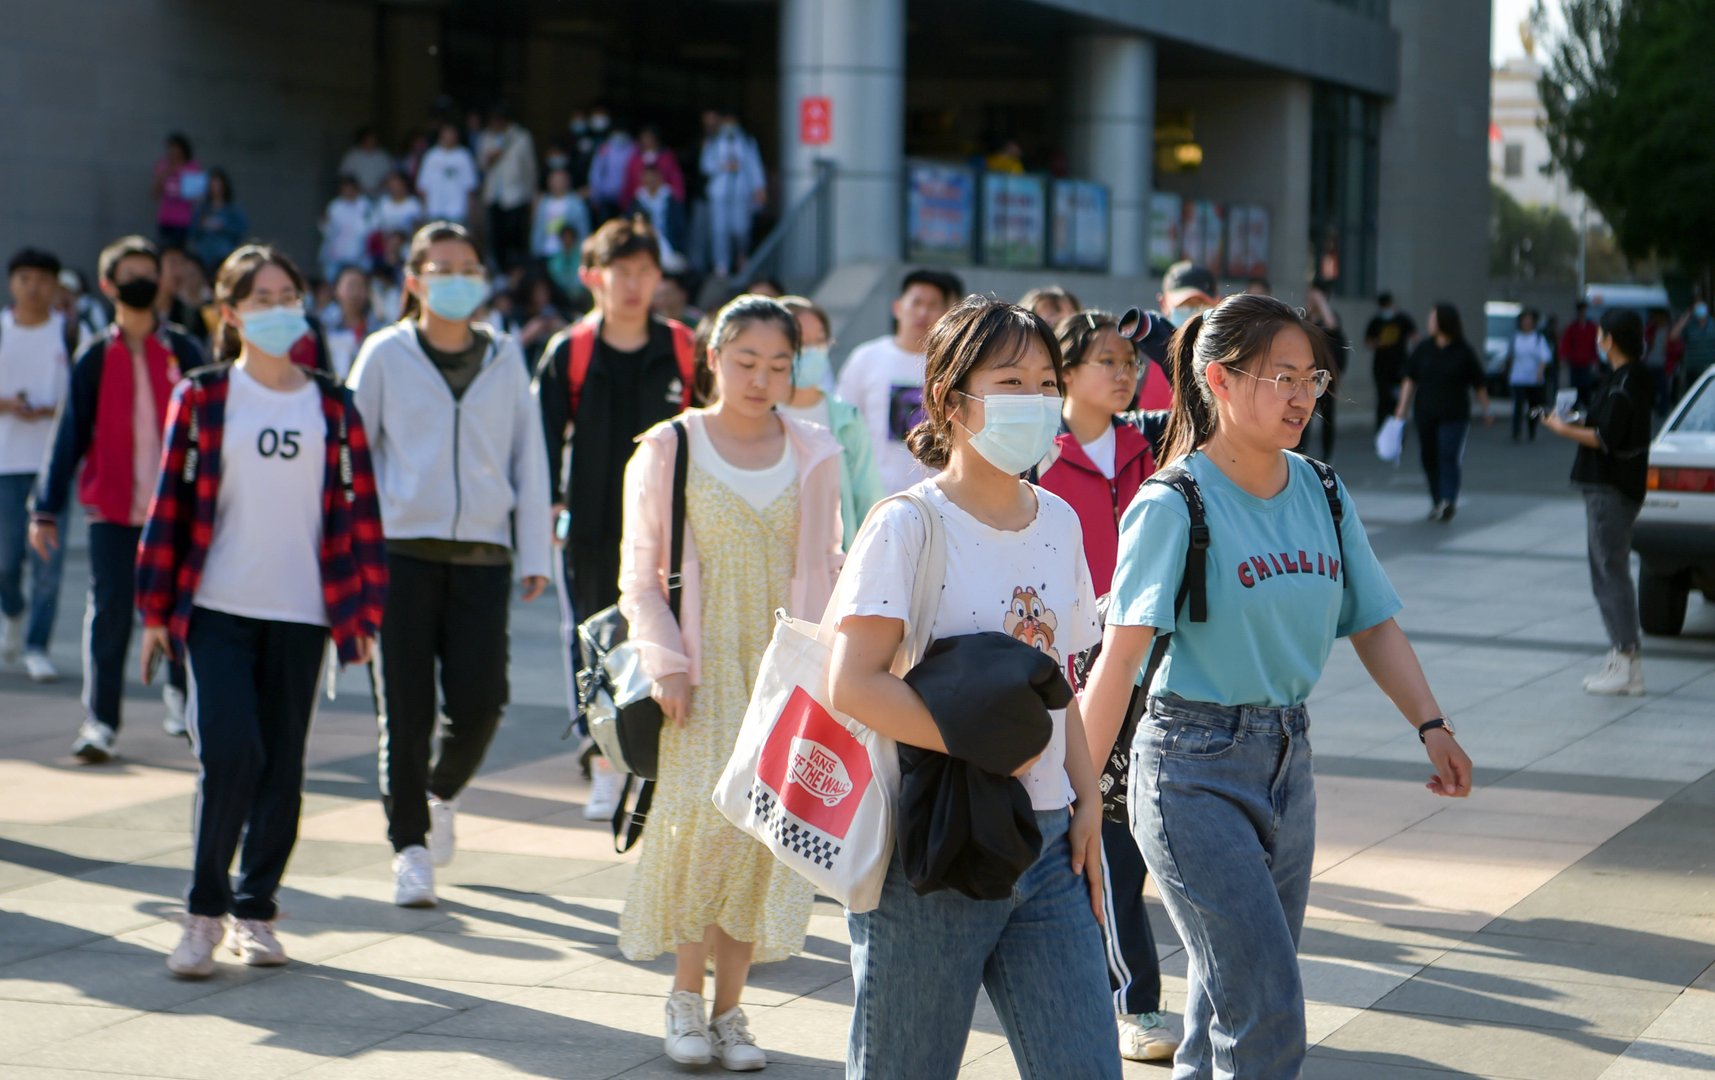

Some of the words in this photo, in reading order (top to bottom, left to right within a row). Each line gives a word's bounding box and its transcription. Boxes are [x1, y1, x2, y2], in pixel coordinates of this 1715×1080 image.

[257, 428, 301, 460] 05
[809, 745, 837, 774] VANS
[801, 761, 825, 788] THE
[820, 774, 847, 794] WALL
